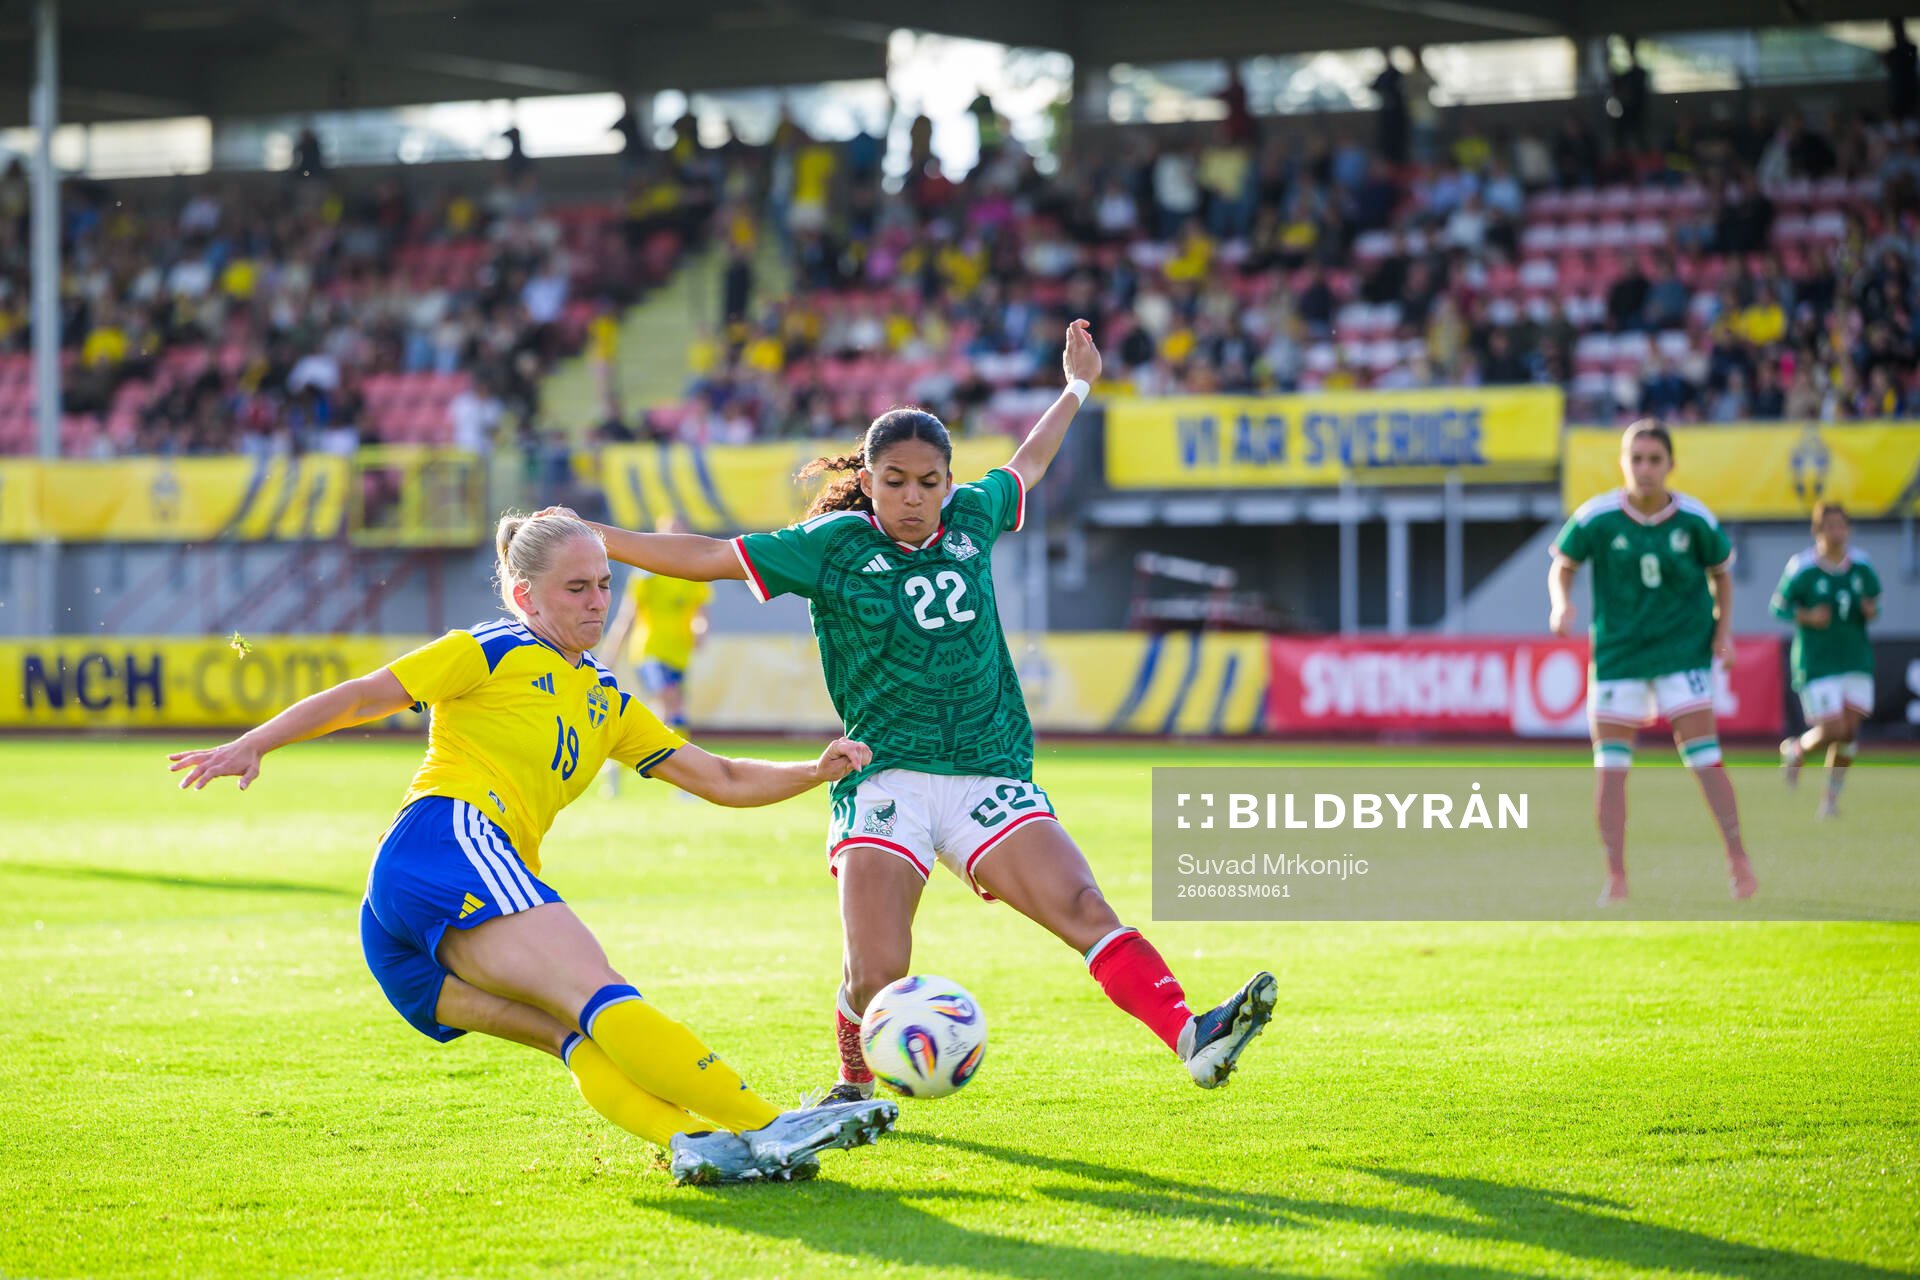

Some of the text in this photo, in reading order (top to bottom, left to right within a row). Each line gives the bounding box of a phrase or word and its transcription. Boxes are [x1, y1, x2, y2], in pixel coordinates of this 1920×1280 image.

[904, 570, 976, 630] 22
[1301, 652, 1509, 716] SVENSKA
[551, 714, 579, 781] 19
